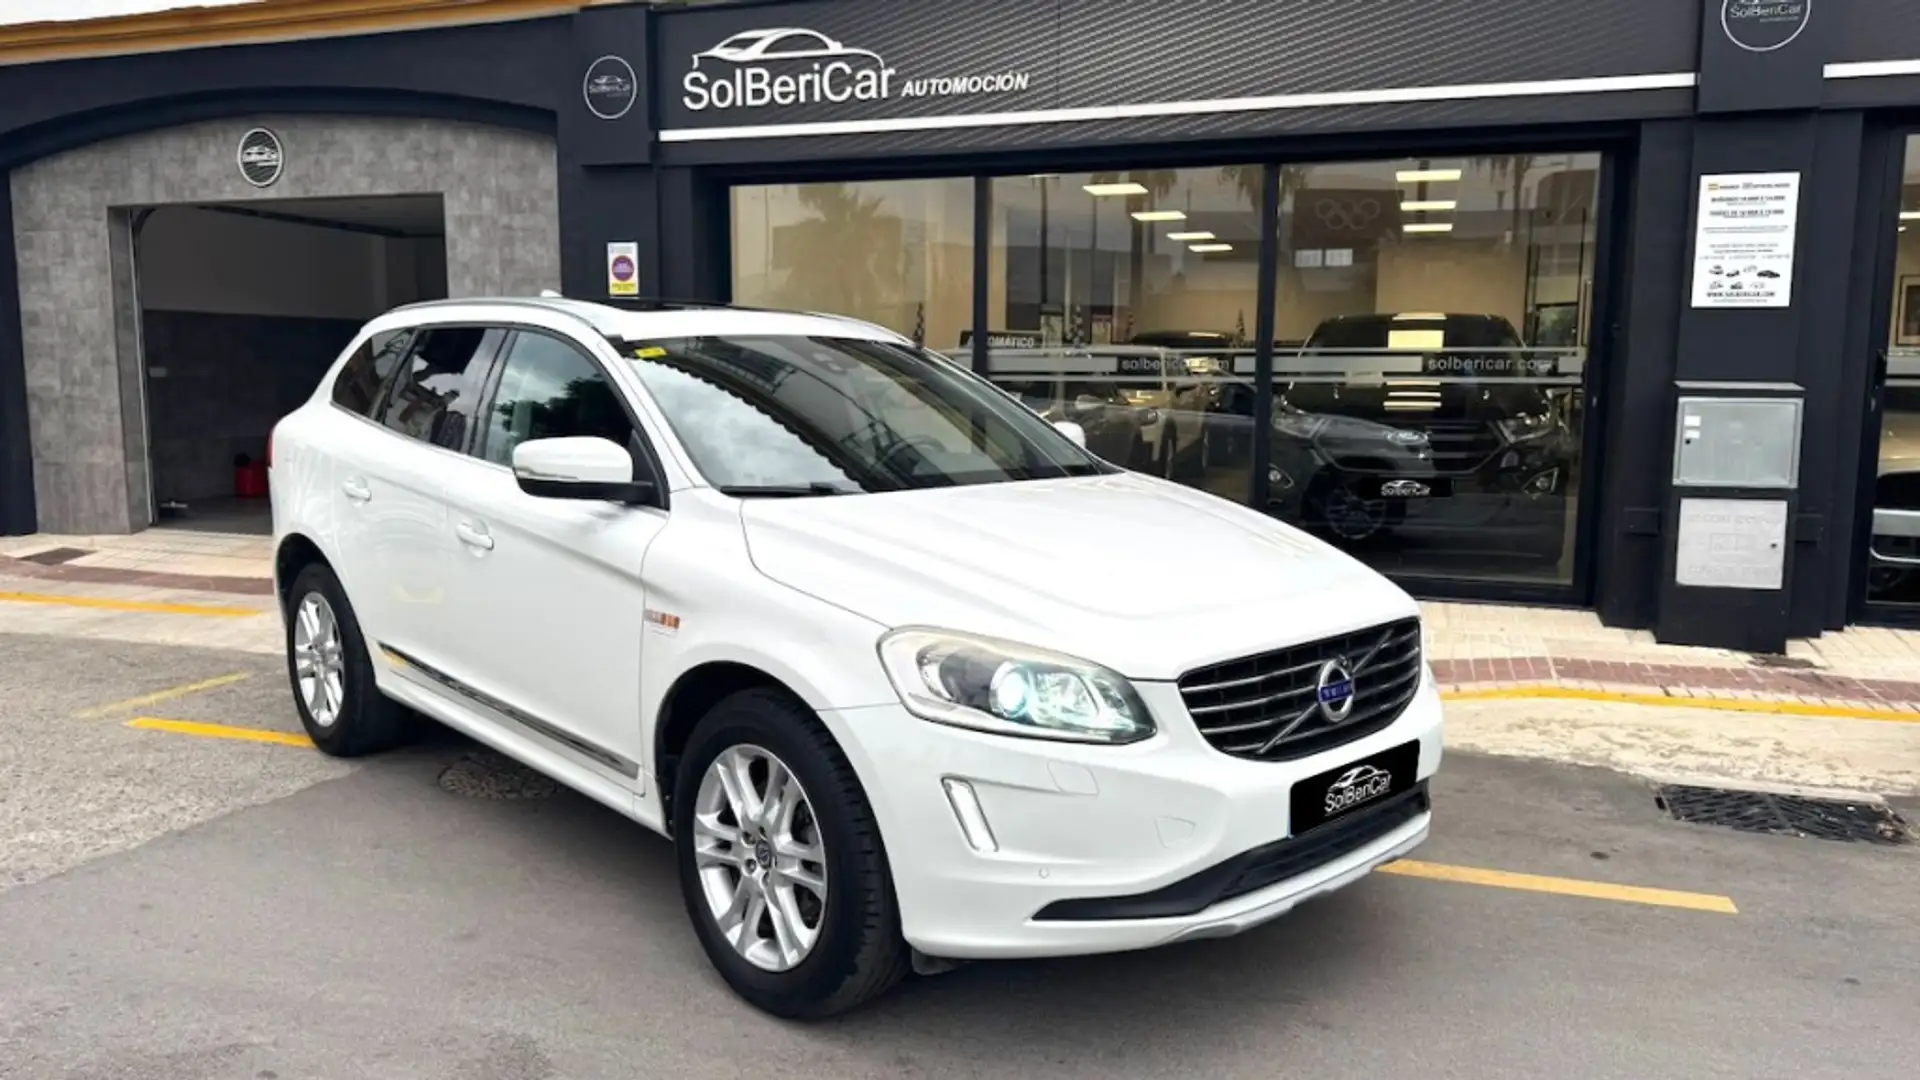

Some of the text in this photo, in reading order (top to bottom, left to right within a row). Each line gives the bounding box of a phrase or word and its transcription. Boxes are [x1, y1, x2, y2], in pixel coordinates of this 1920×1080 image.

[683, 61, 1030, 110] SolBeriCar AUTOMOCIÓN
[1324, 774, 1392, 812] SolBeriCar
